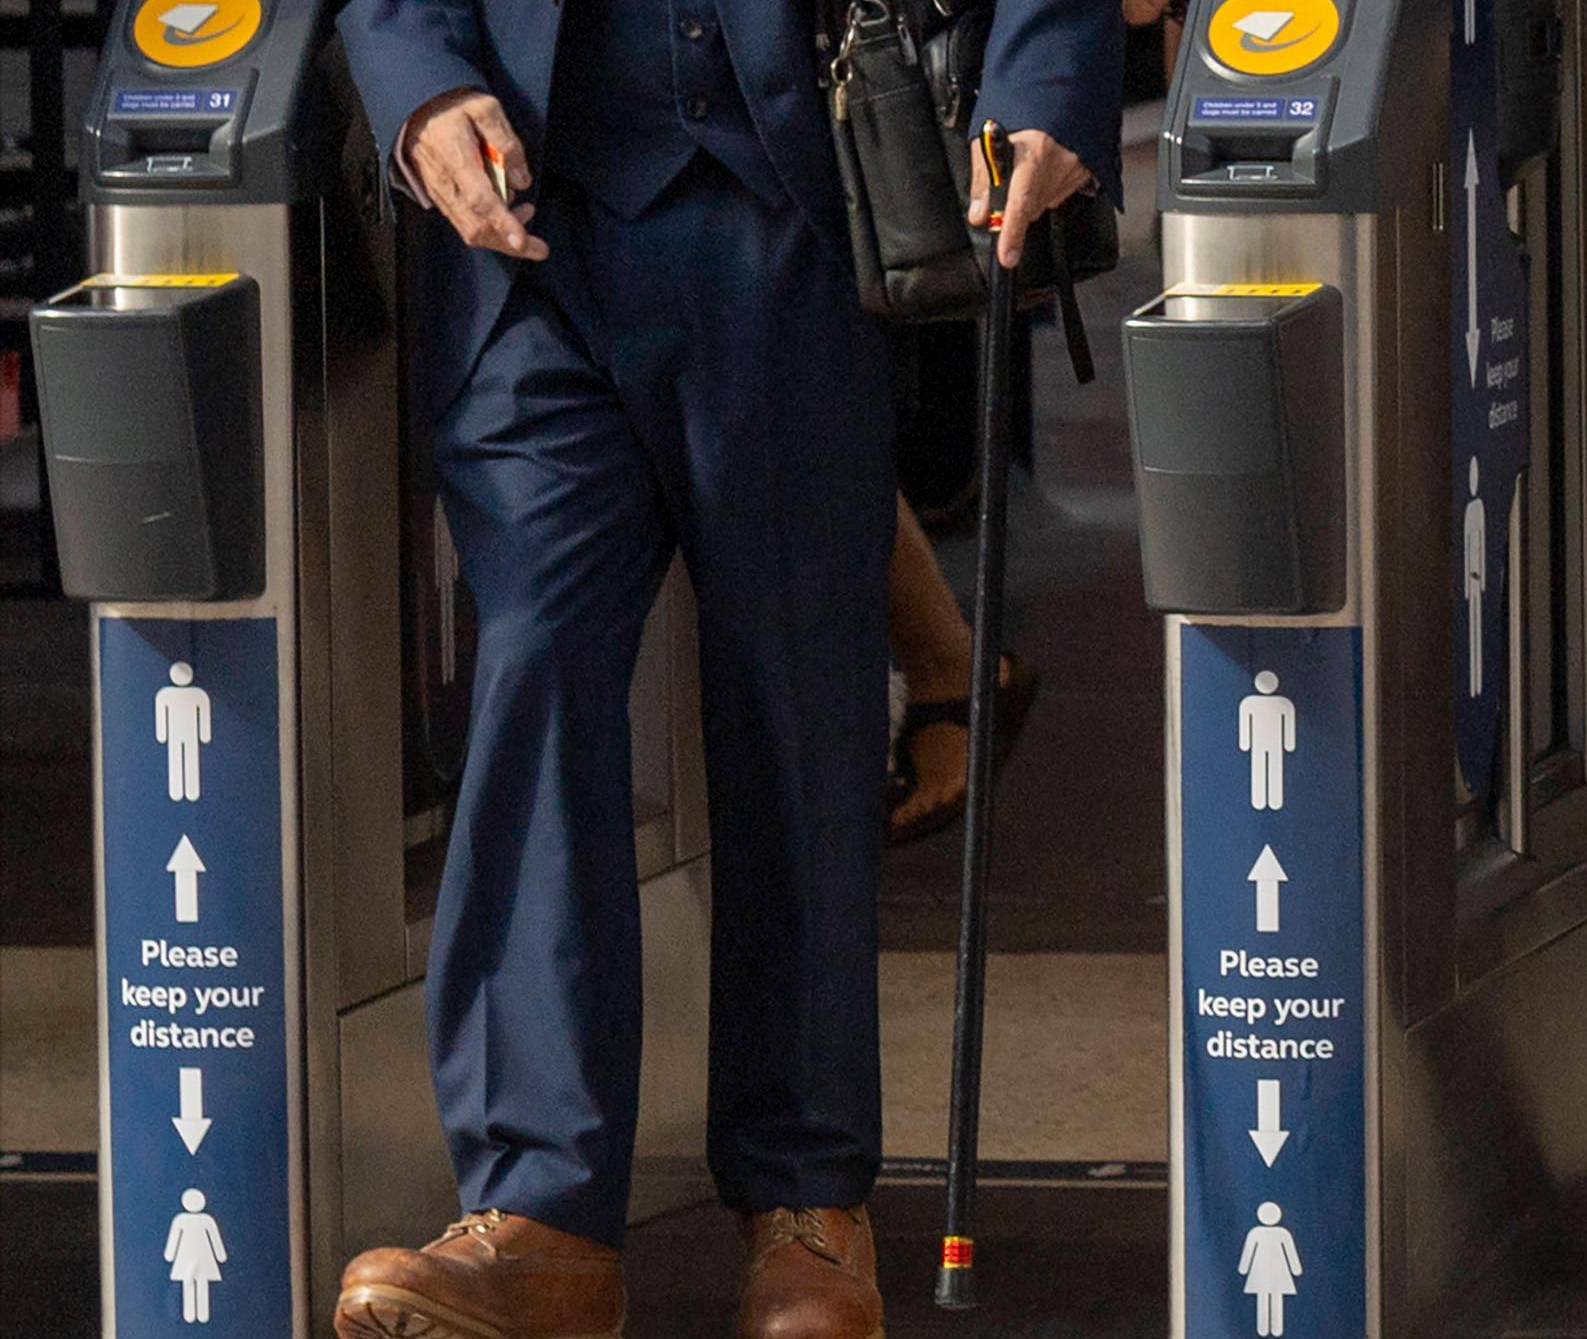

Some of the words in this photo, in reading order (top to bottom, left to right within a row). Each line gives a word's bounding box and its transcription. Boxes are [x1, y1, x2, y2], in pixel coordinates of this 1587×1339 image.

[208, 92, 231, 108] 31
[1289, 101, 1314, 116] 32
[142, 940, 238, 967] Please
[1220, 950, 1318, 977] Please
[122, 978, 187, 1014] keep
[194, 986, 265, 1015] your
[1198, 989, 1266, 1025] keep
[1274, 998, 1345, 1025] your
[131, 1020, 255, 1048] distance
[1207, 1031, 1334, 1059] distance
